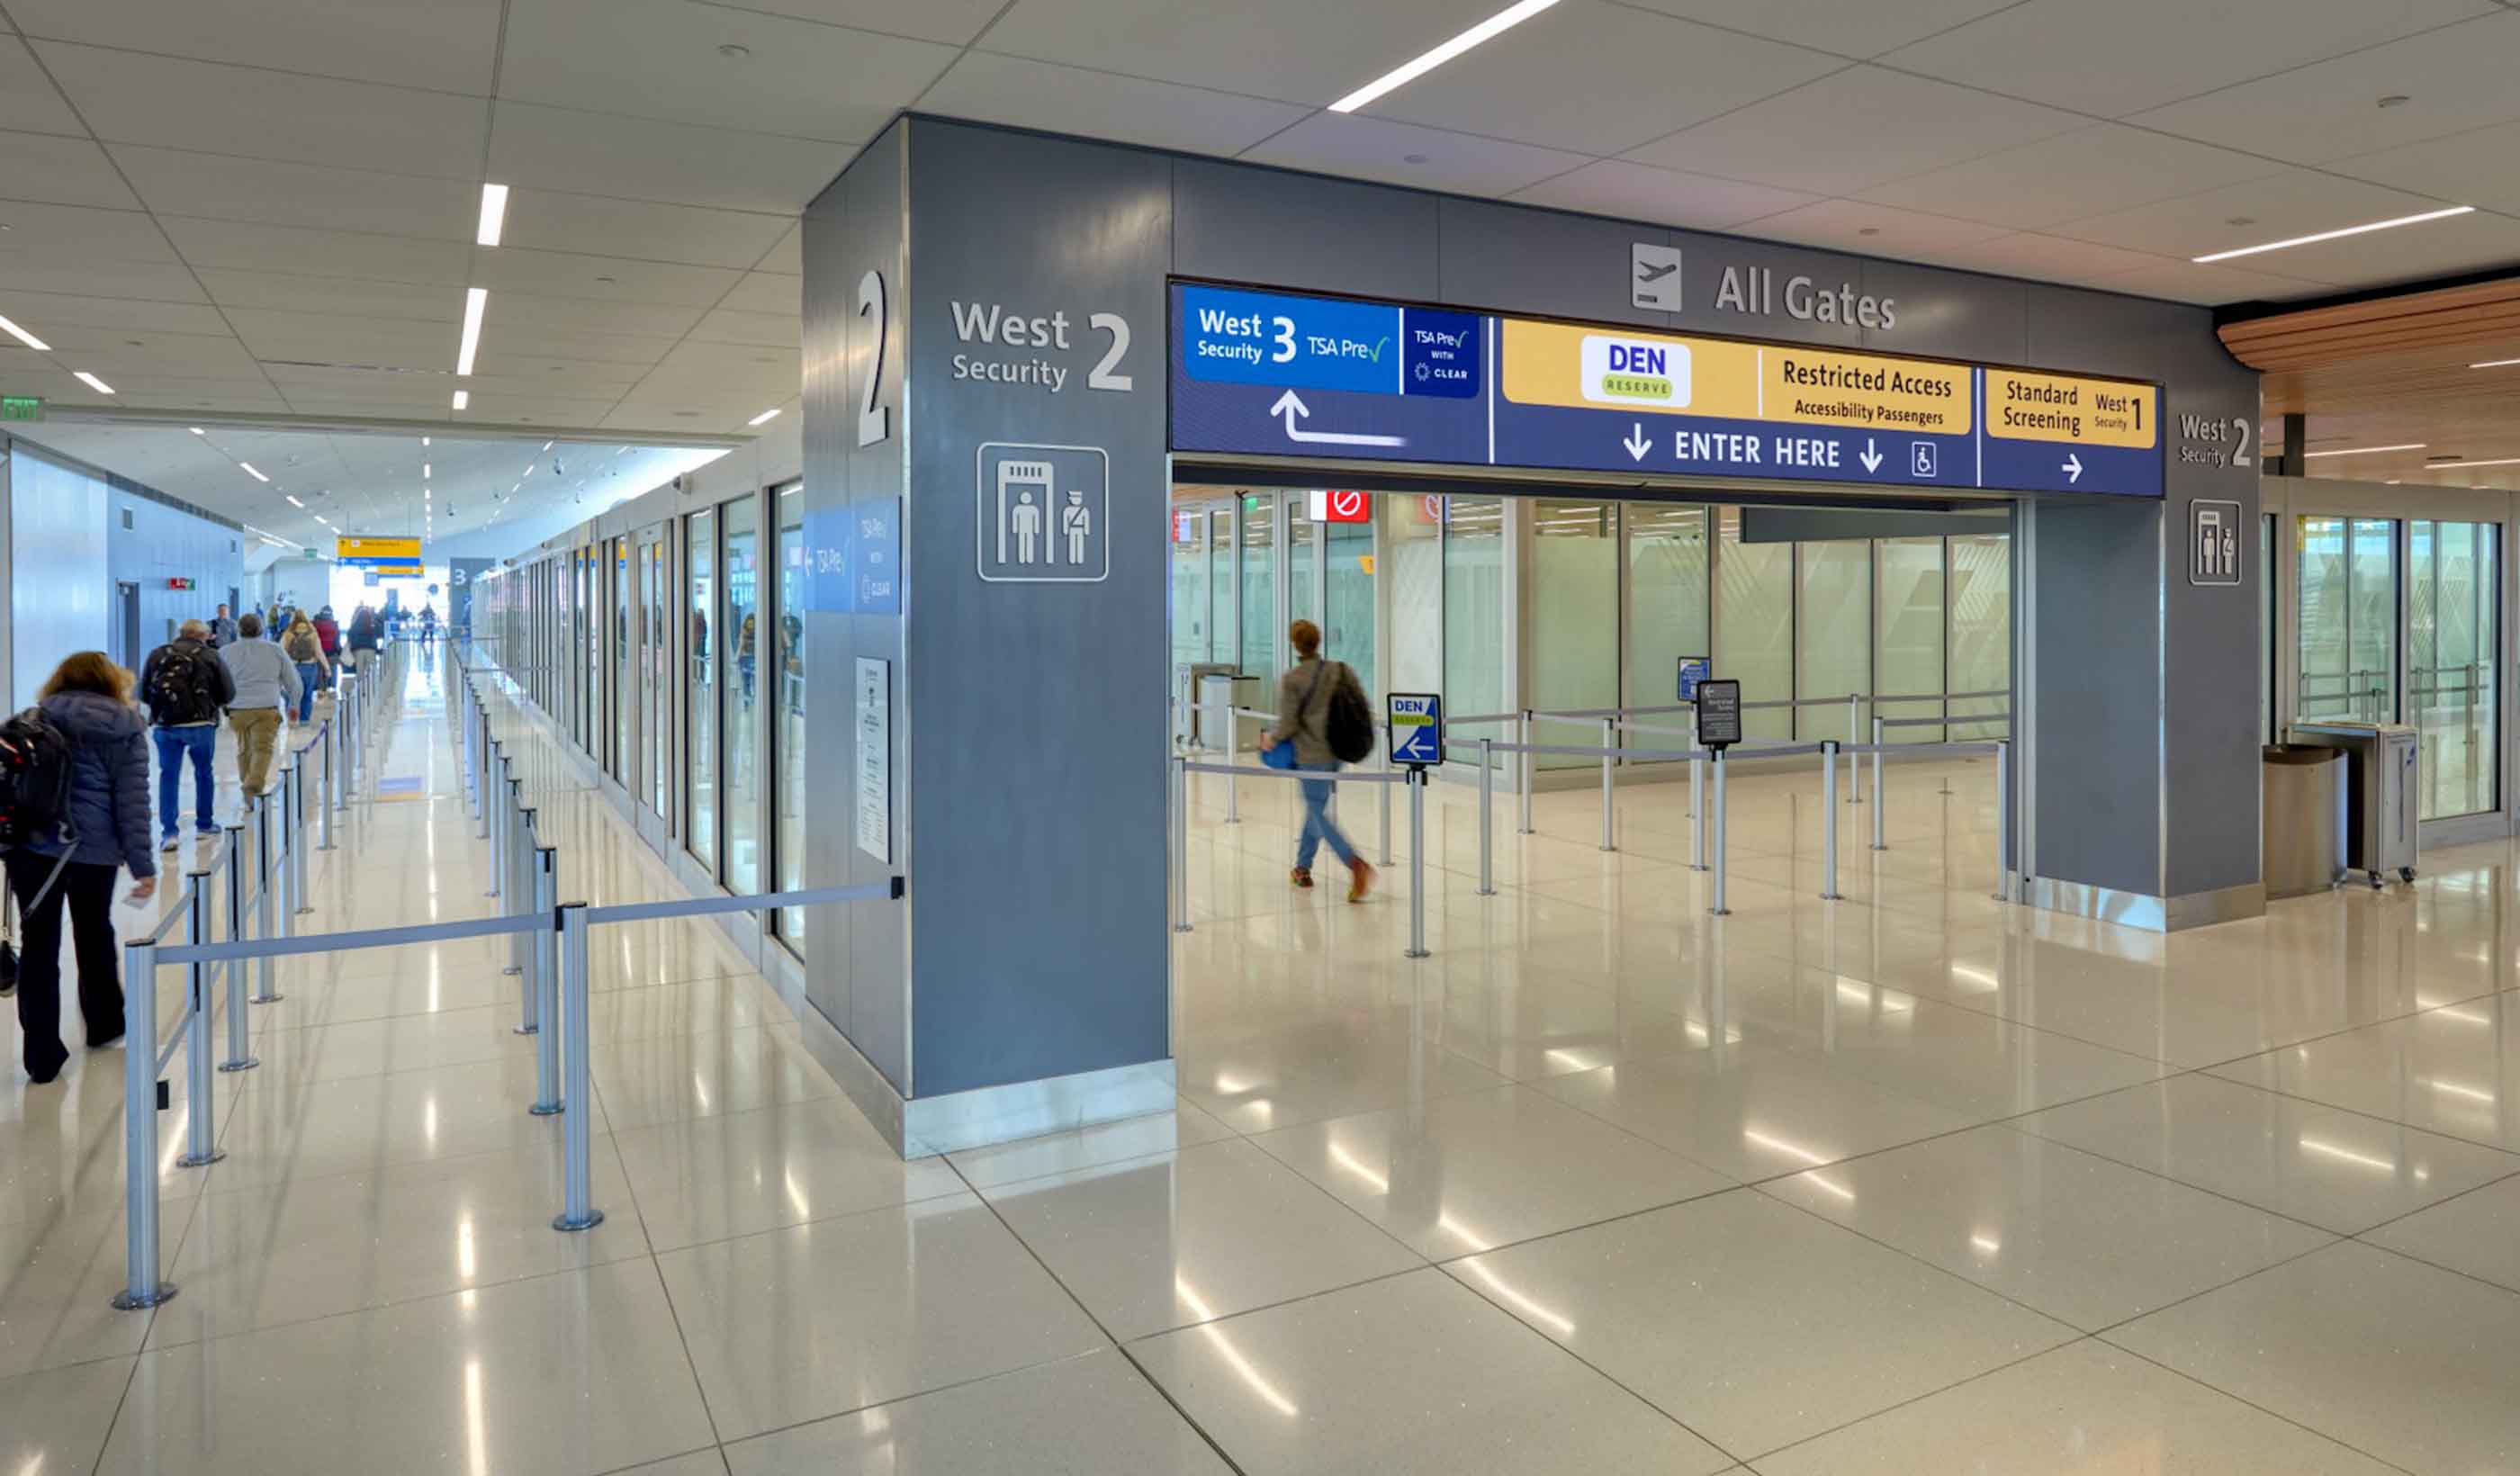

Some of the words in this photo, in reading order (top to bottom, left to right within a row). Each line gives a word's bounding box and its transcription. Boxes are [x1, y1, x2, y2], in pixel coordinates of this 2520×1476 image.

[1715, 266, 1771, 314] All
[1785, 276, 1895, 329] Gates
[951, 302, 1071, 349] West
[1088, 312, 1133, 392] 2
[1199, 309, 1263, 338] West
[1272, 317, 1297, 363] 3
[1308, 336, 1338, 356] TSA
[1342, 339, 1368, 359] Pre
[1414, 330, 1436, 344] TSA
[859, 271, 887, 447] 2
[1198, 340, 1263, 364] Security
[1431, 350, 1454, 360] WITH
[1609, 345, 1666, 375] DEN
[952, 356, 1067, 393] Security
[1434, 368, 1468, 380] CLEAR
[1607, 379, 1669, 394] RESERVE
[1783, 360, 1886, 392] Restricted
[1891, 371, 1952, 398] Access
[2007, 380, 2078, 405] Standard
[1795, 400, 1874, 423] Accessibility
[1877, 406, 1944, 426] Passengers
[2003, 406, 2081, 436] Screening
[2094, 416, 2127, 432] Security
[2095, 393, 2128, 412] West
[2131, 397, 2141, 430] 1
[1675, 431, 1761, 464] ENTER
[1776, 436, 1840, 467] HERE
[2179, 414, 2226, 441] West
[2232, 418, 2251, 466] 2
[2180, 446, 2226, 468] Security
[454, 568, 466, 585] 3
[1395, 700, 1423, 712] DEN
